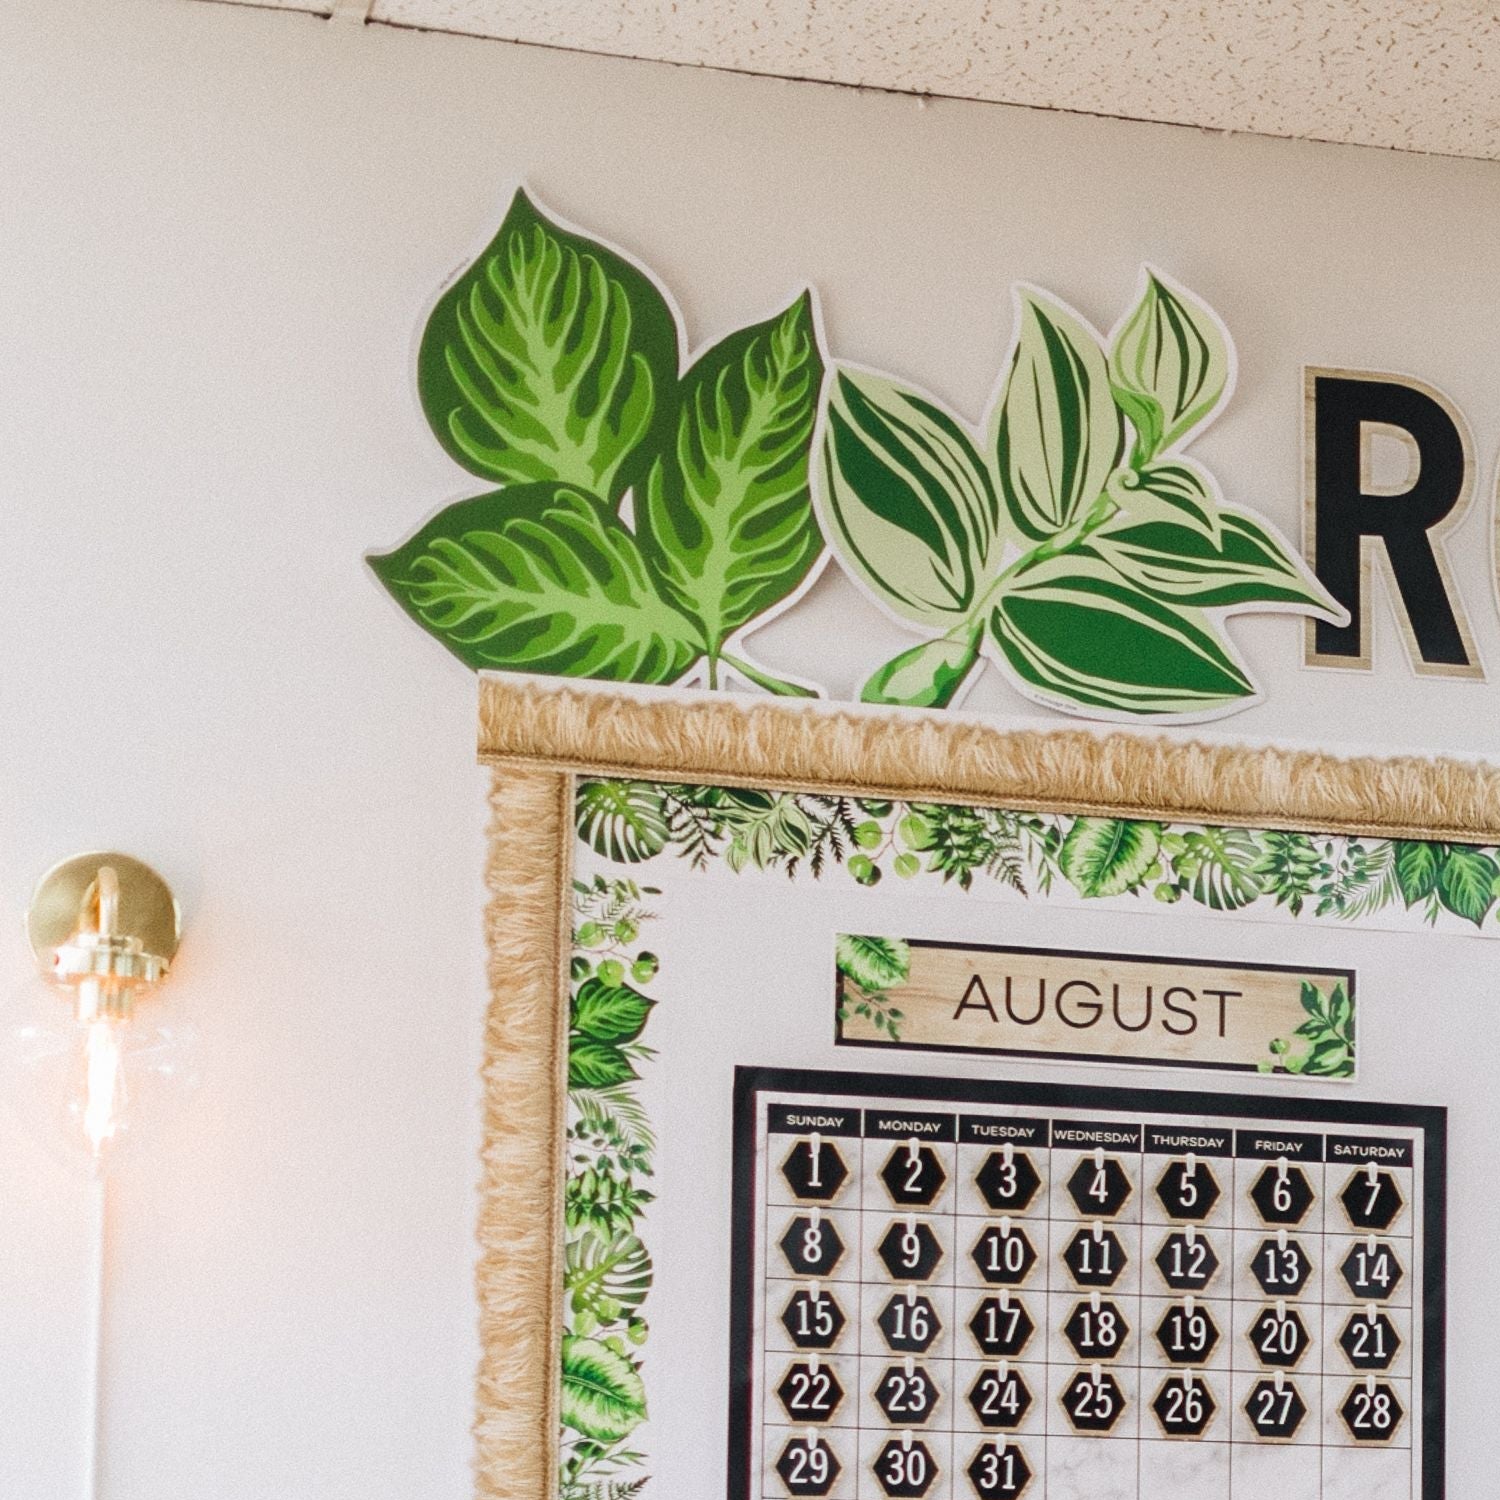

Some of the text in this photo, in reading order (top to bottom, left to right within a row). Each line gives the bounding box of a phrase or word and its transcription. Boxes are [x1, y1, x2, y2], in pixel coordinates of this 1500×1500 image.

[952, 974, 1243, 1037] AUGUST
[786, 1114, 1405, 1158] SUNDAY MONDAY TUESDAY WEDNESDAY THURSDAY FRIDAY SATURDAY
[808, 1152, 1381, 1216] 1 2 3 4 5 6 7
[803, 1228, 1390, 1287] 8 9 10 11 12 13 14
[797, 1301, 1387, 1358] 15 16 17 18 19 20 21
[791, 1373, 1391, 1428] 22 23 24 25 26 27 28
[789, 1448, 1016, 1490] 29 30 31
